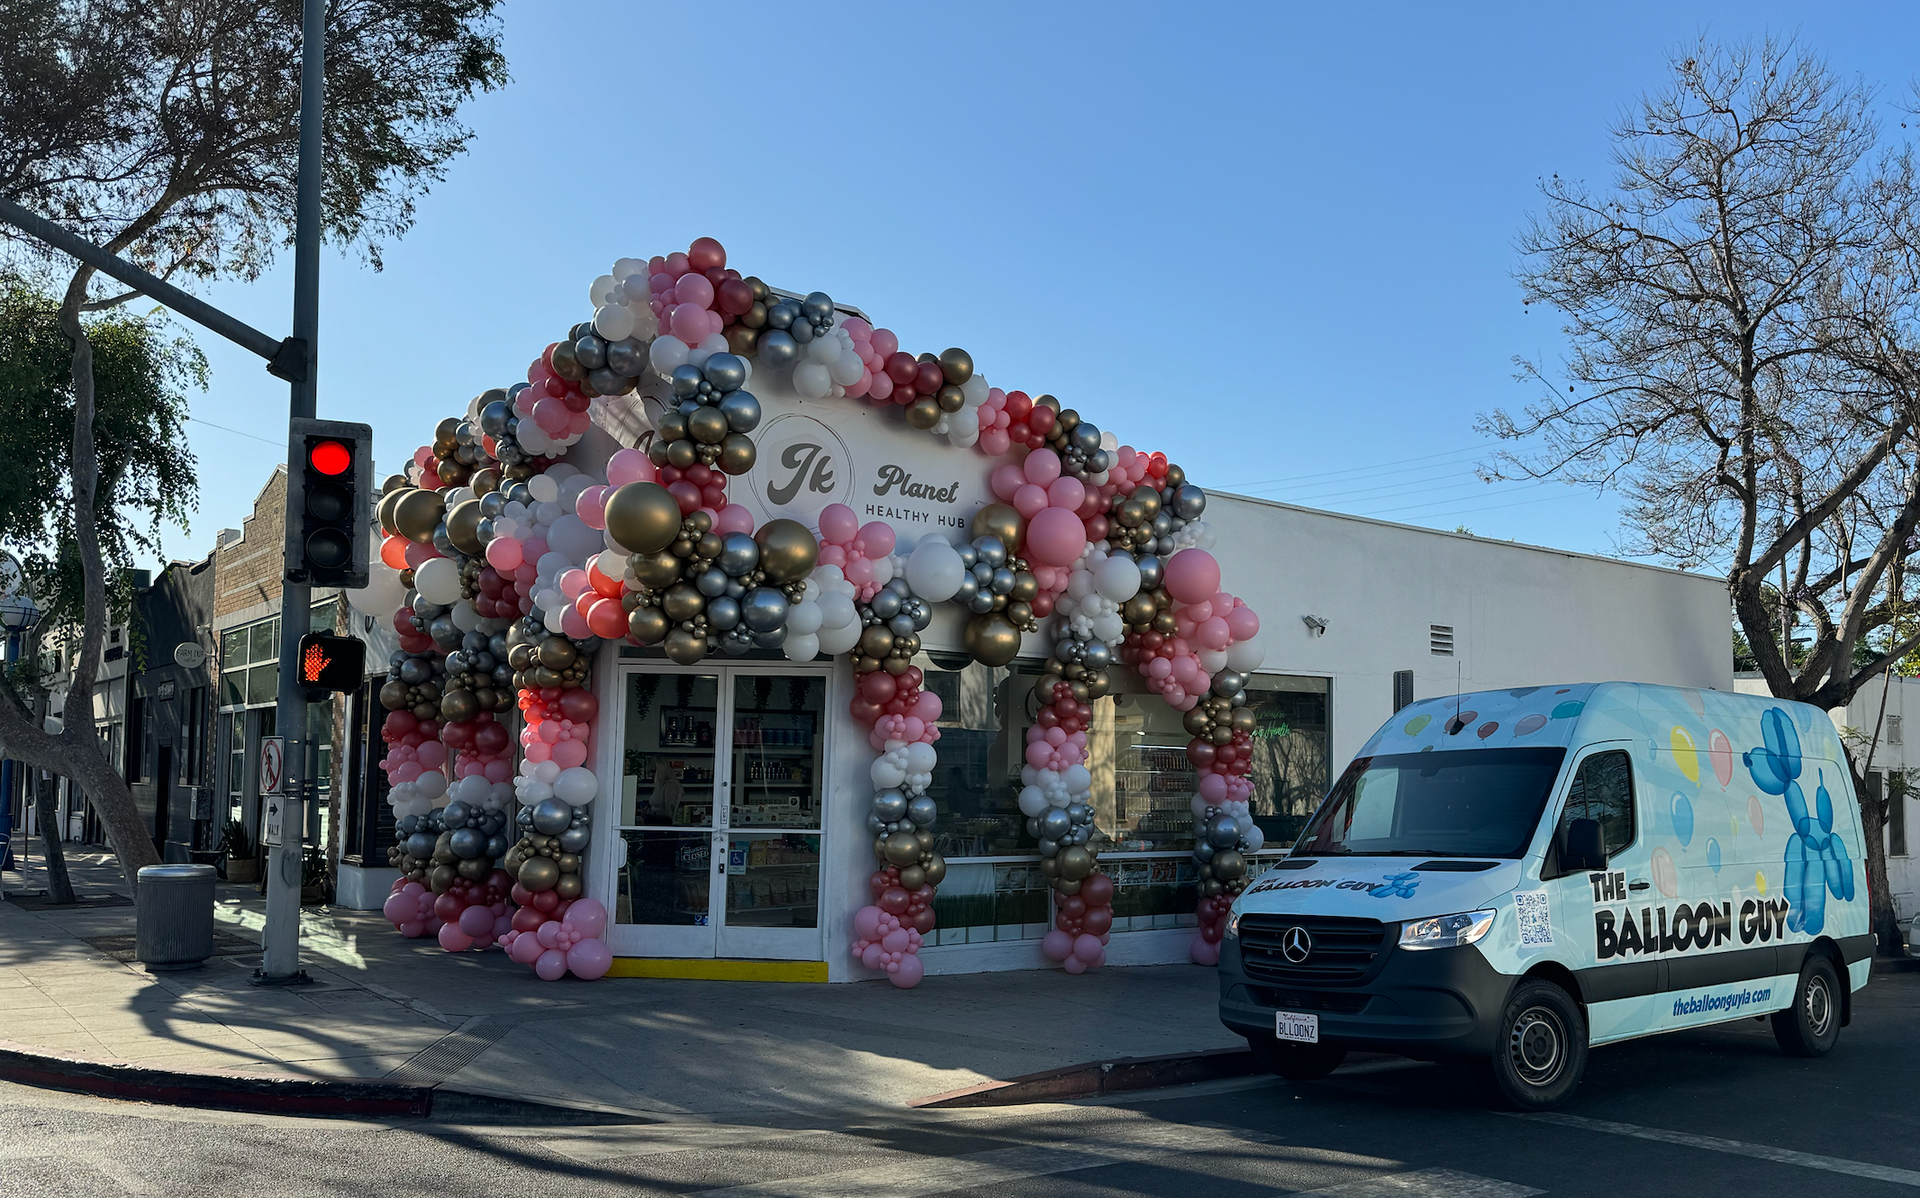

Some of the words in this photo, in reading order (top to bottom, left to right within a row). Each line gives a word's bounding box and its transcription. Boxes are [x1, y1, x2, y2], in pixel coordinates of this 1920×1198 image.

[873, 464, 959, 503] Planet
[866, 504, 930, 523] HEALTHY
[937, 515, 965, 528] HUB
[176, 648, 192, 657] FARM
[193, 649, 204, 658] CUP
[1247, 879, 1337, 896] BALLOON
[1335, 880, 1384, 893] GUY
[1589, 872, 1627, 903] THE
[1594, 901, 1732, 960] BALLOON
[1738, 896, 1790, 945] GUY
[1672, 987, 1771, 1017] theballoonguyla.com
[1279, 1021, 1315, 1039] BLLOONZ
